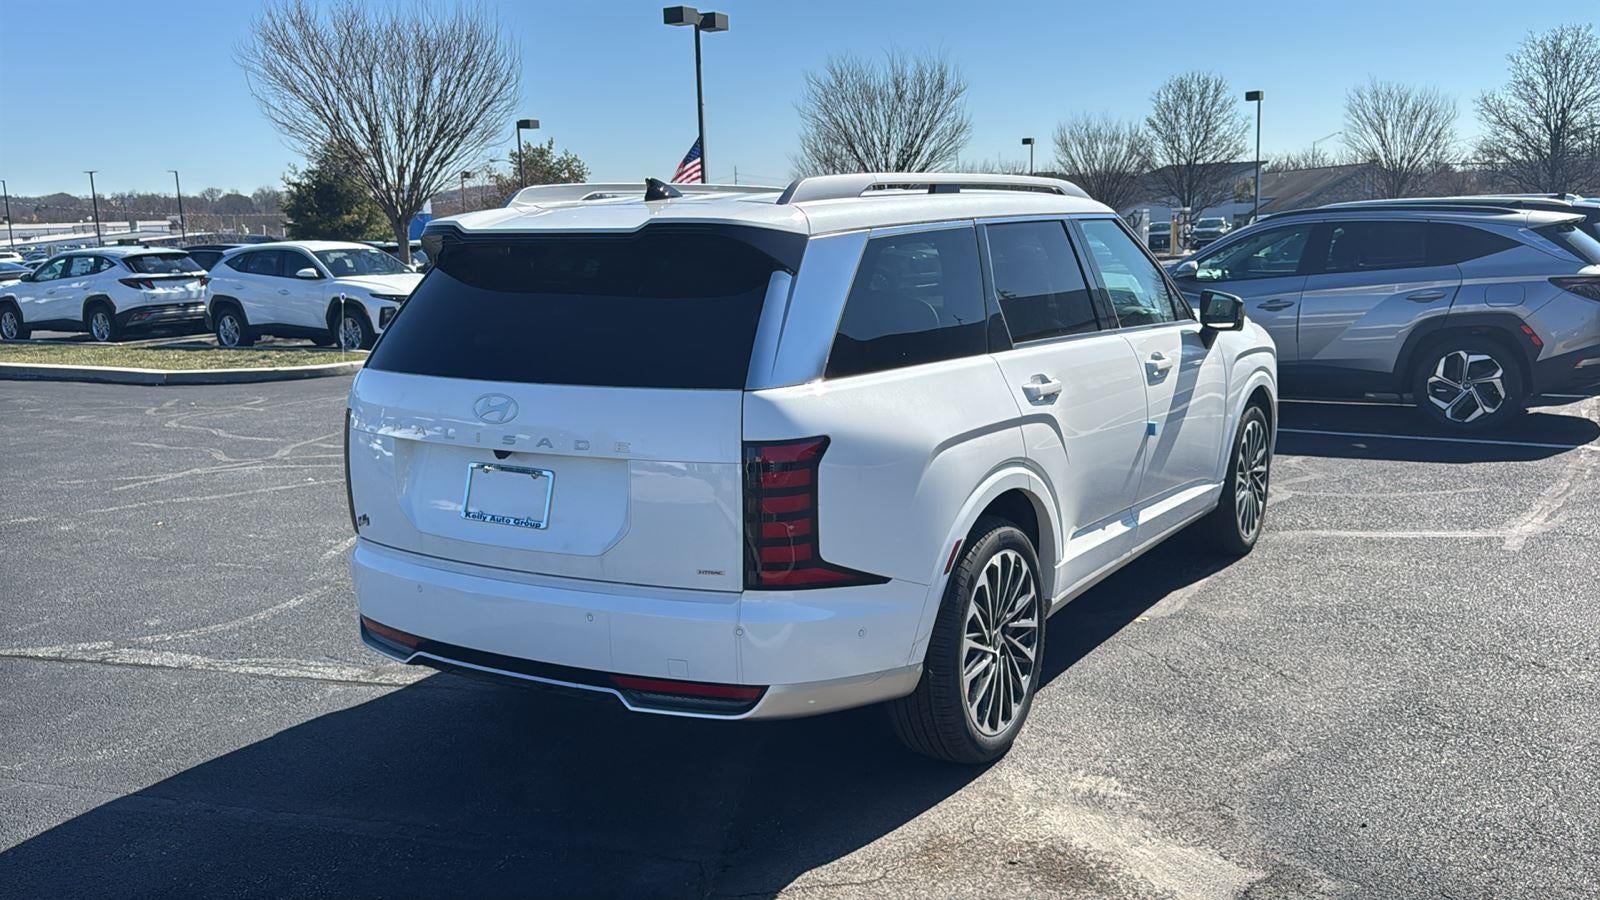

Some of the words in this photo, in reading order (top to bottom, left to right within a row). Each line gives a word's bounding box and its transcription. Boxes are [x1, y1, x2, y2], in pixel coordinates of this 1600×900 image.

[393, 423, 632, 453] PALISADE
[464, 511, 487, 522] Kelly
[490, 515, 511, 523] Auto
[513, 518, 541, 528] Group
